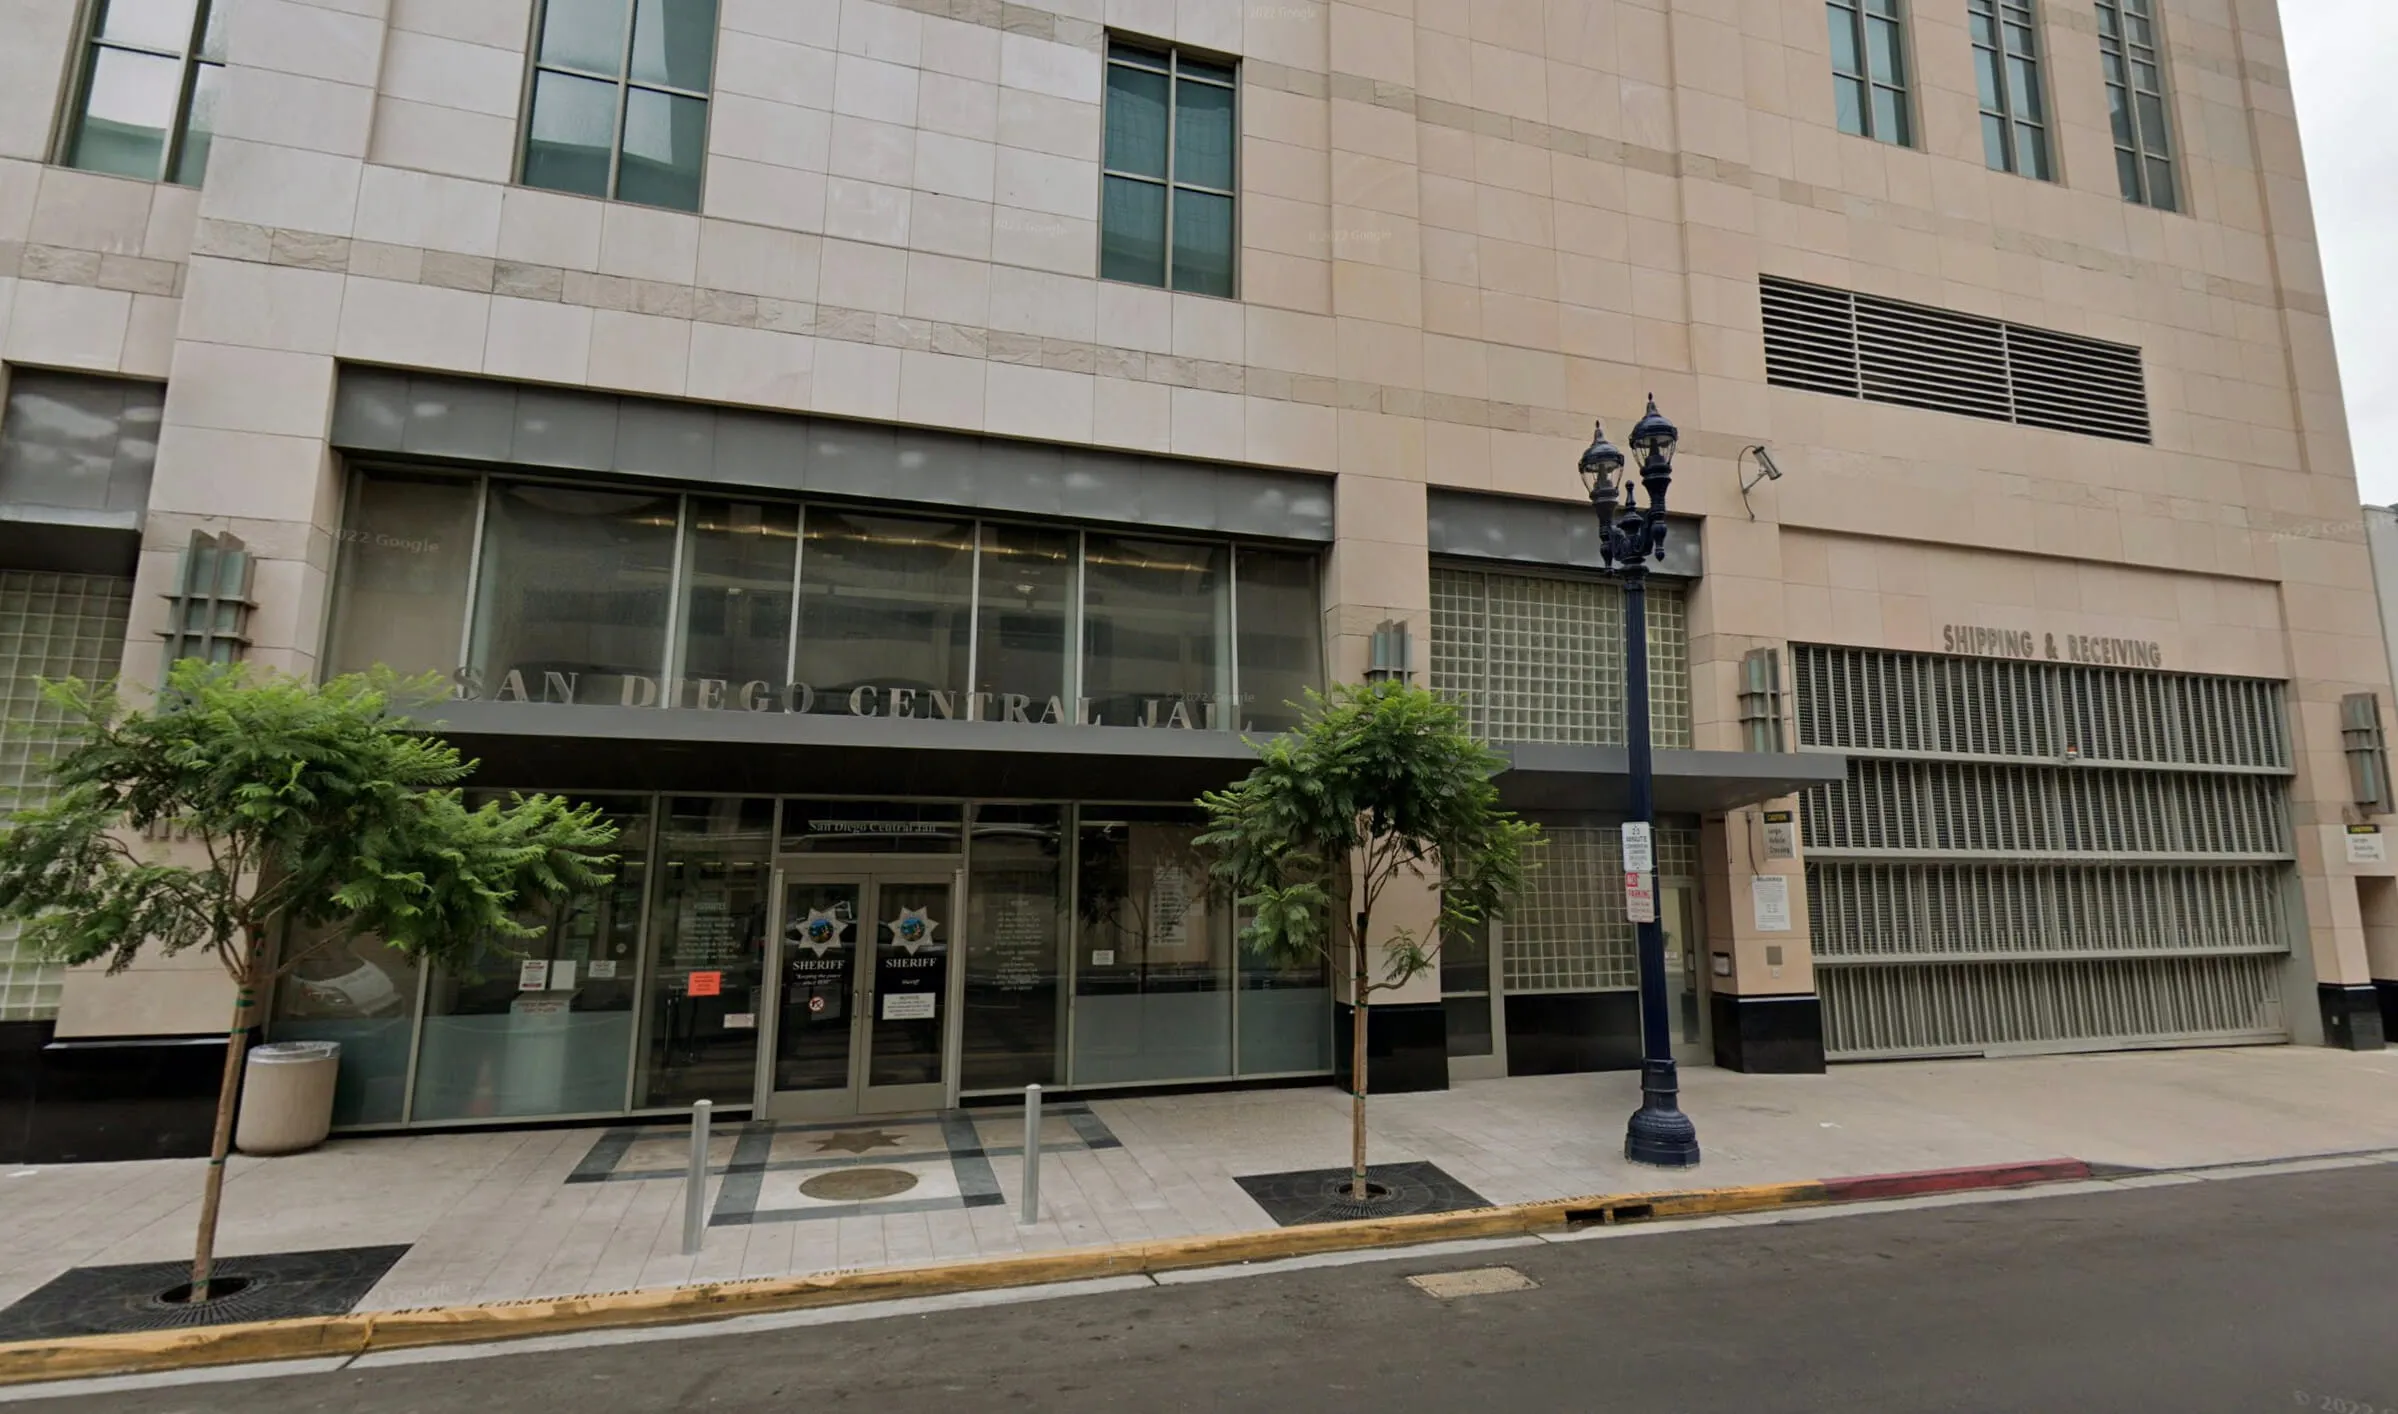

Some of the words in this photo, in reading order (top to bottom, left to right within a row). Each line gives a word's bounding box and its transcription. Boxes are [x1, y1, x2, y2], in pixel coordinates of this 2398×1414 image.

[1943, 624, 2034, 658] SHIPPING
[2045, 632, 2059, 660] &
[2066, 634, 2162, 668] RECEIVING
[452, 666, 580, 705] SAN
[620, 674, 815, 715] DIEGO
[849, 685, 1101, 727] CENTRAL
[1137, 698, 1254, 734] JAIL
[808, 821, 831, 833] San
[834, 822, 867, 836] Diego
[869, 822, 913, 834] Central
[792, 959, 846, 971] SHERIFF
[885, 957, 937, 969] SHERIFF
